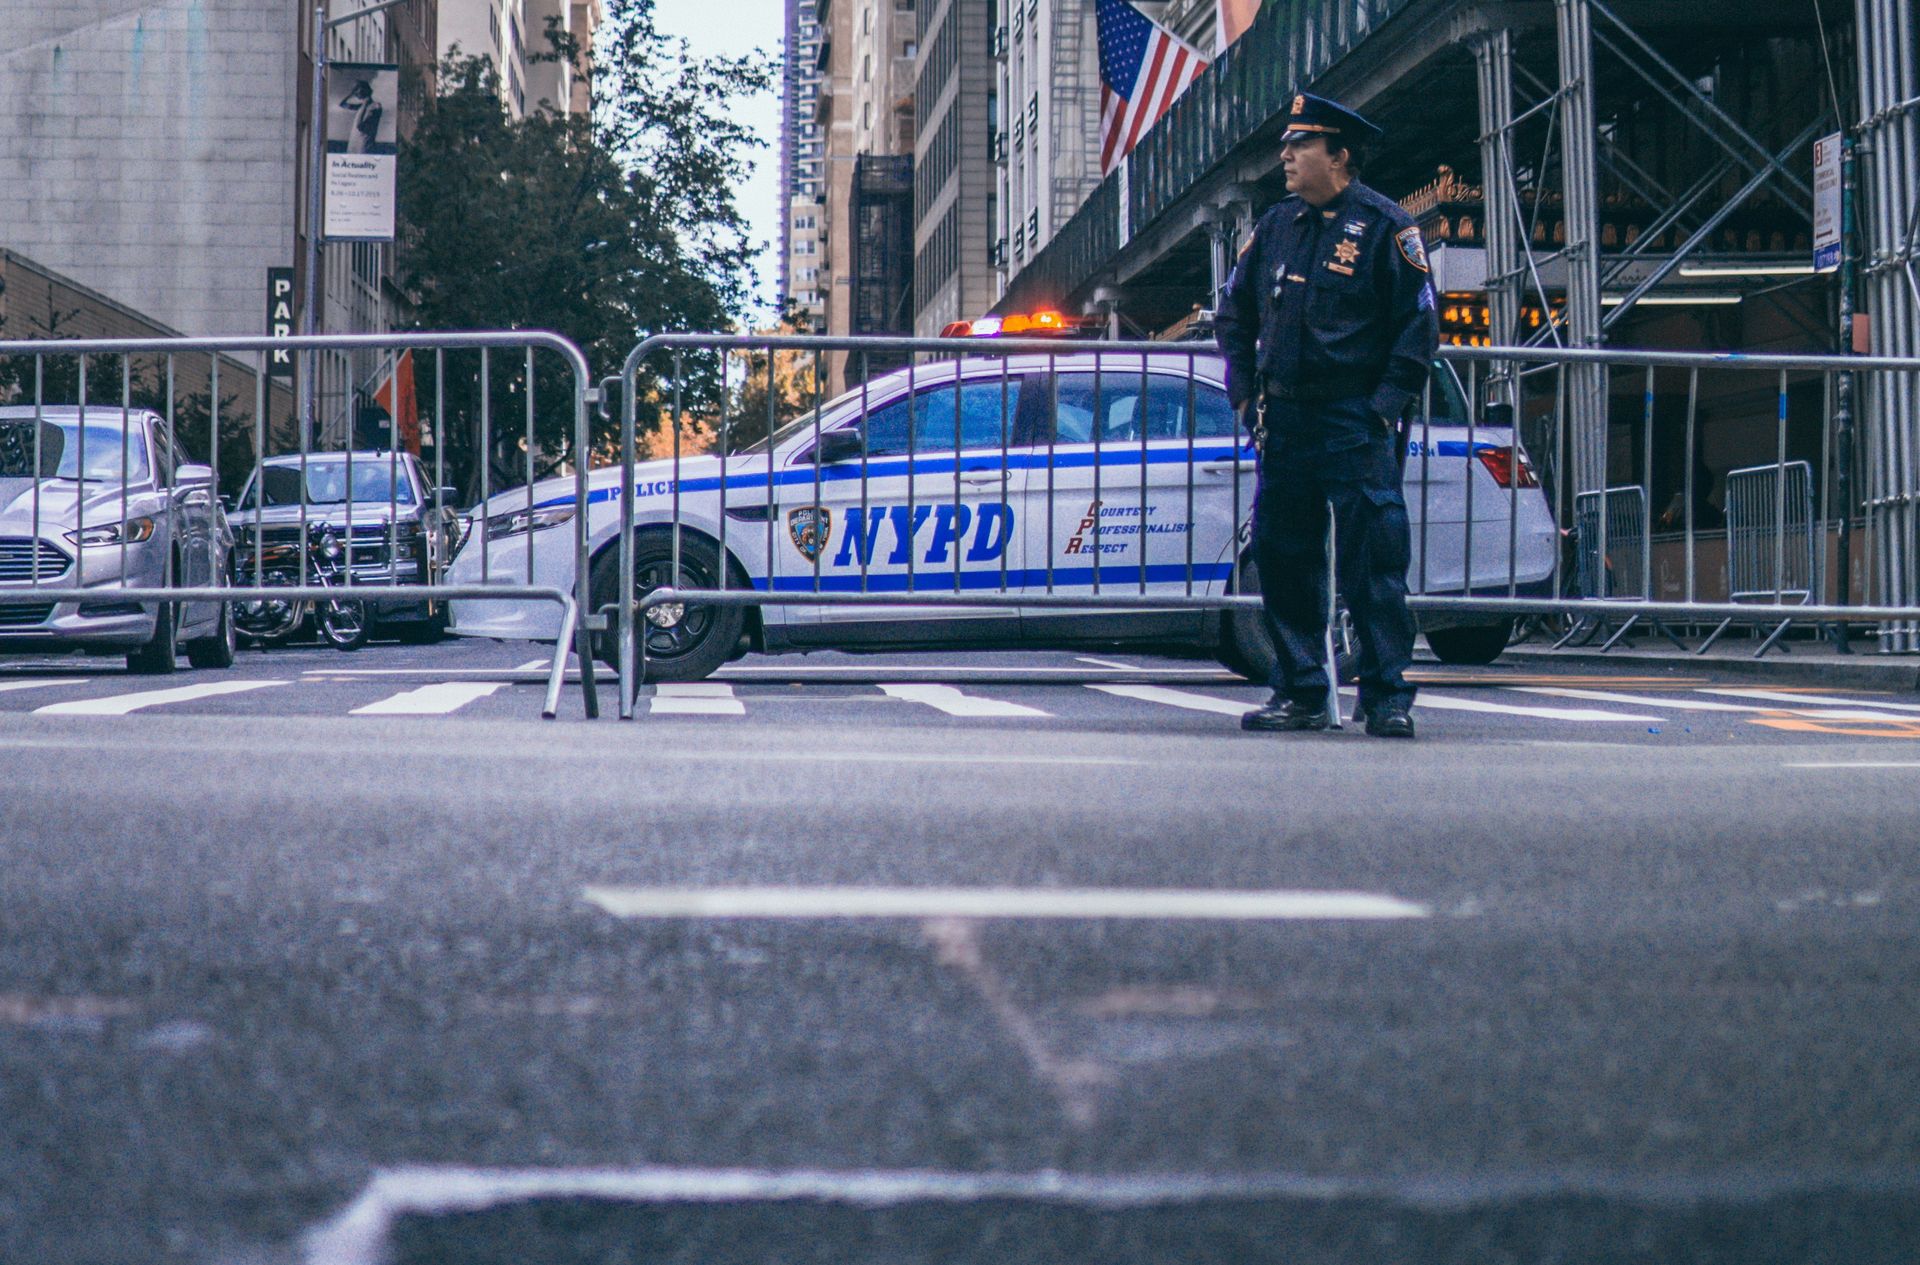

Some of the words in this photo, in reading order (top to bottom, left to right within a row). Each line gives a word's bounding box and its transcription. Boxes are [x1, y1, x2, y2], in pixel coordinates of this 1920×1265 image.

[341, 161, 376, 170] Actuality
[273, 279, 291, 364] PARK
[609, 480, 680, 501] PLICE
[833, 502, 1015, 567] NYPD
[1064, 537, 1128, 555] RESPECT
